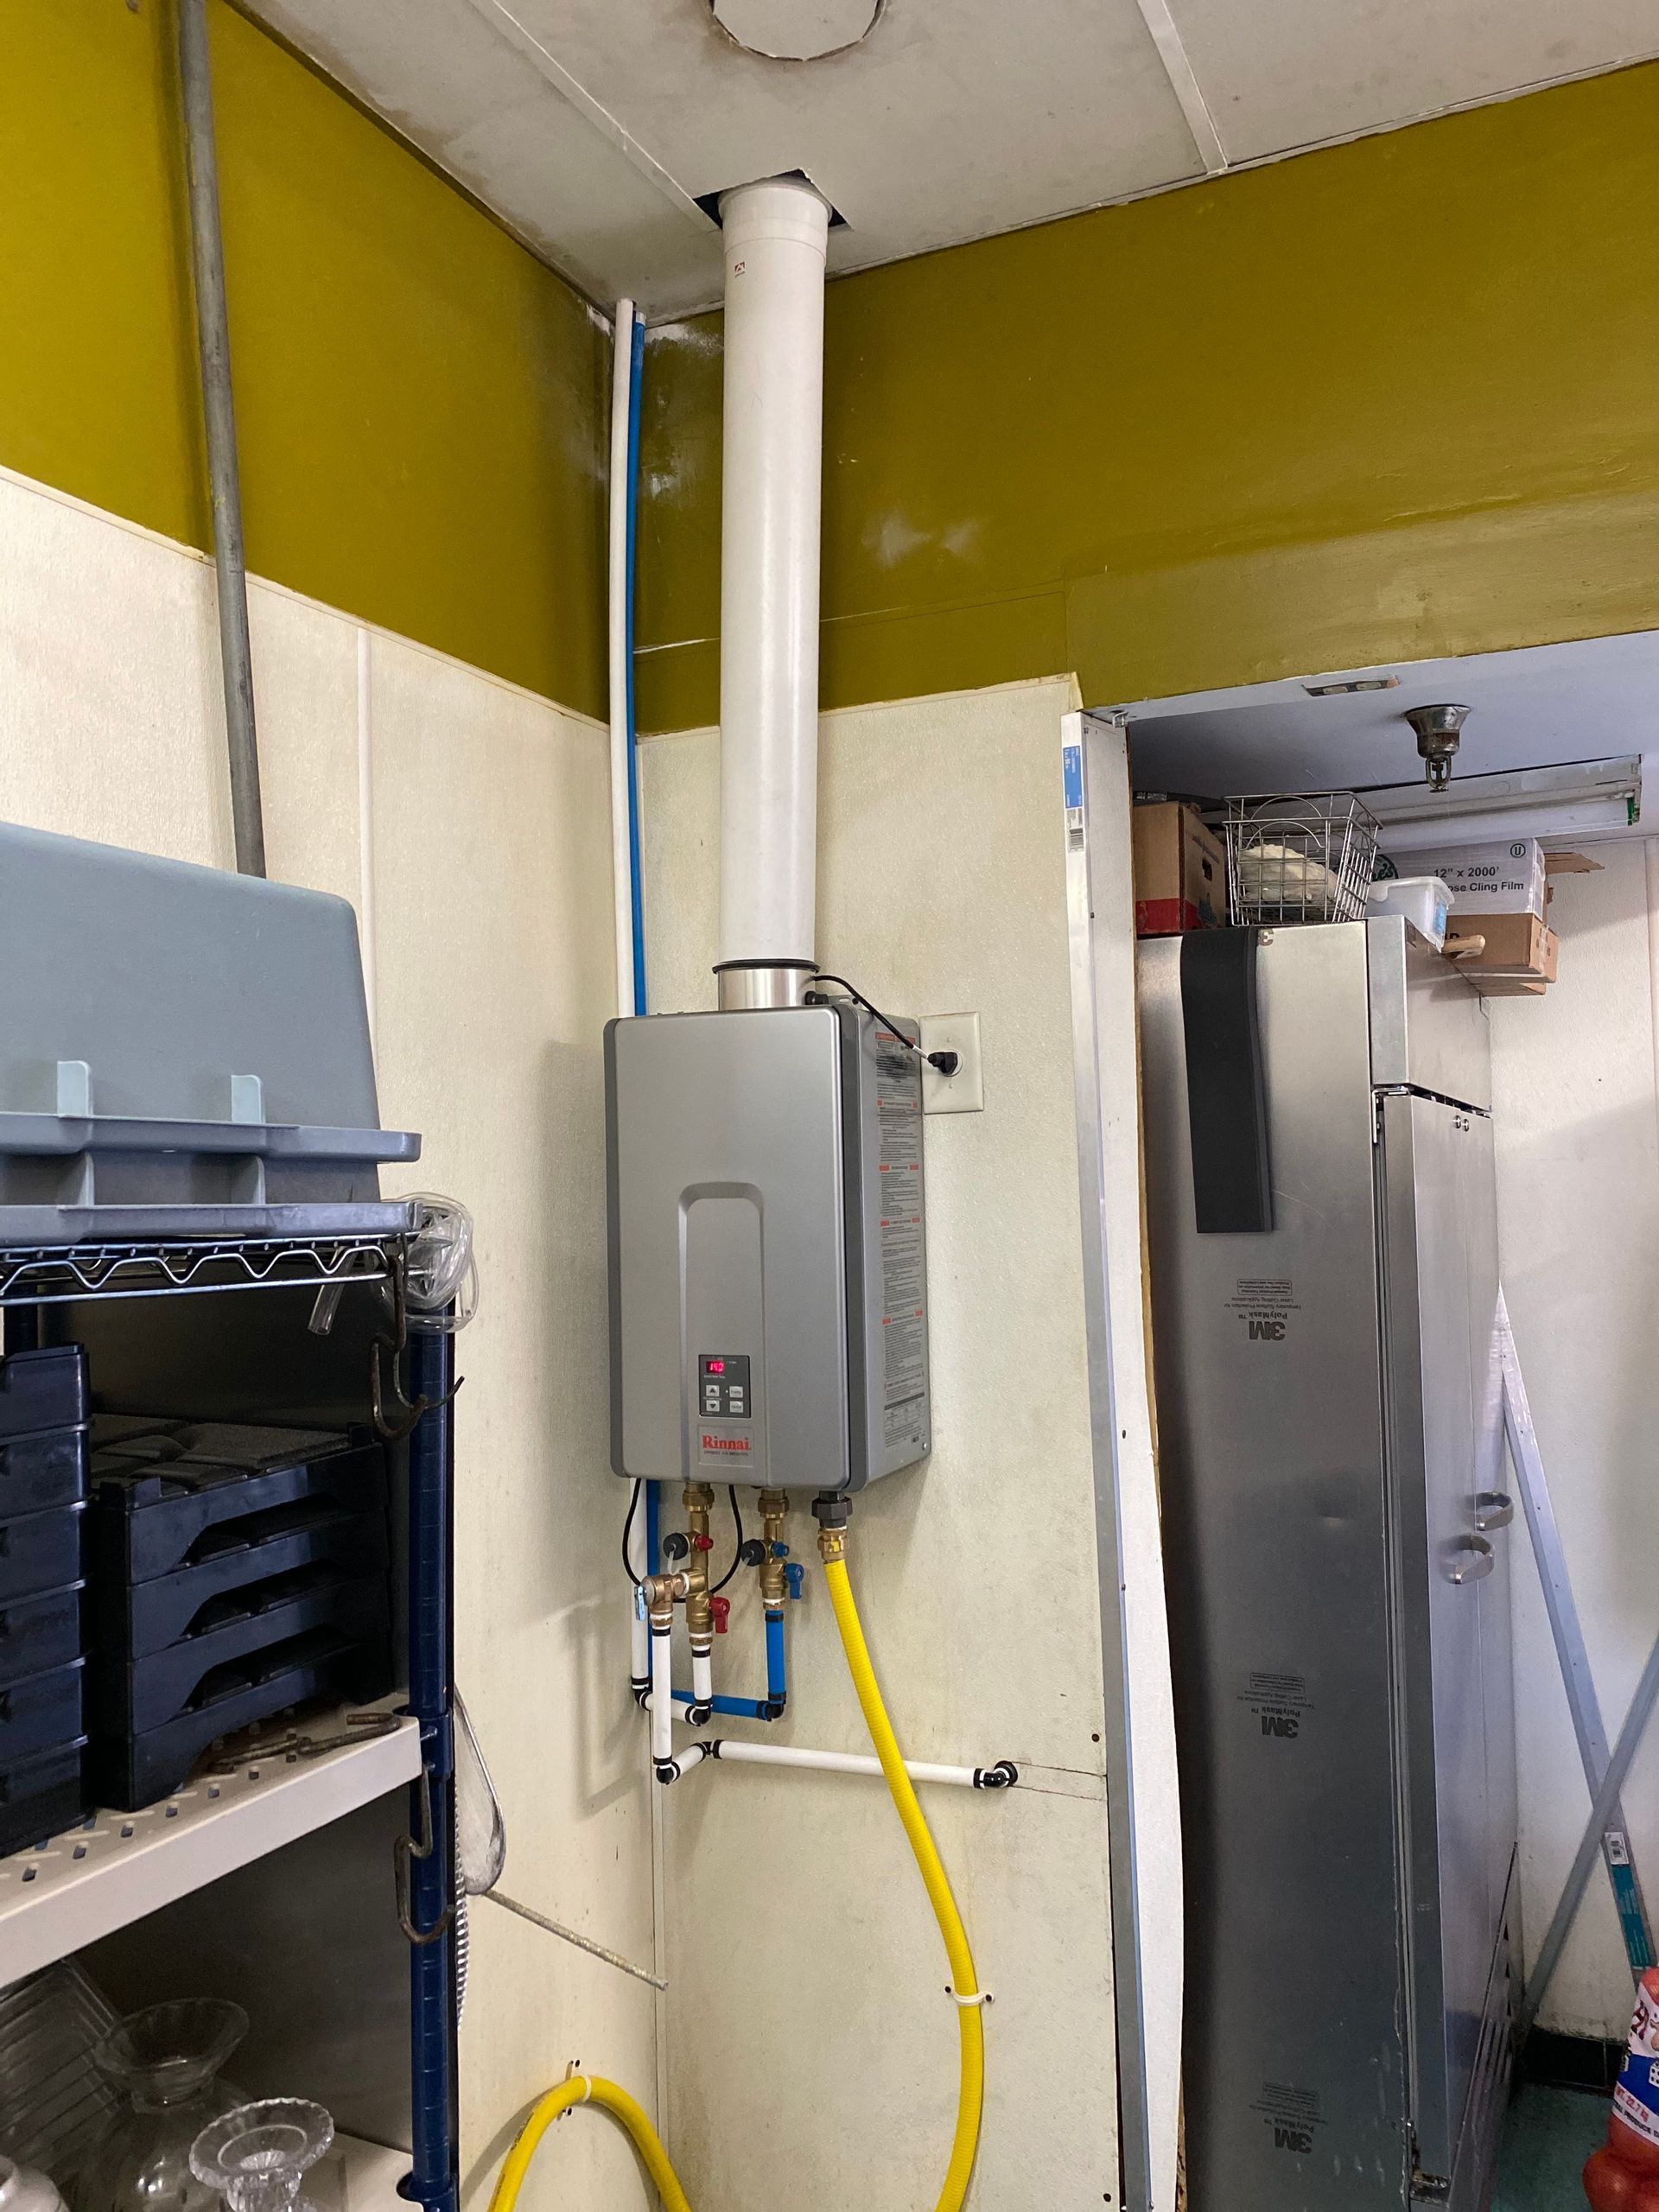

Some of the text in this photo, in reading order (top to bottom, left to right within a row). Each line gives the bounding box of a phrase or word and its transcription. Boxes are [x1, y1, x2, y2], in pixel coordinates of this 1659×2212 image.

[1447, 881, 1524, 893] ose Cling Film
[1249, 1321, 1286, 1340] 3M
[702, 1434, 750, 1452] Rinnai
[1262, 1716, 1299, 1738] 3M
[1274, 2127, 1312, 2154] 3M
